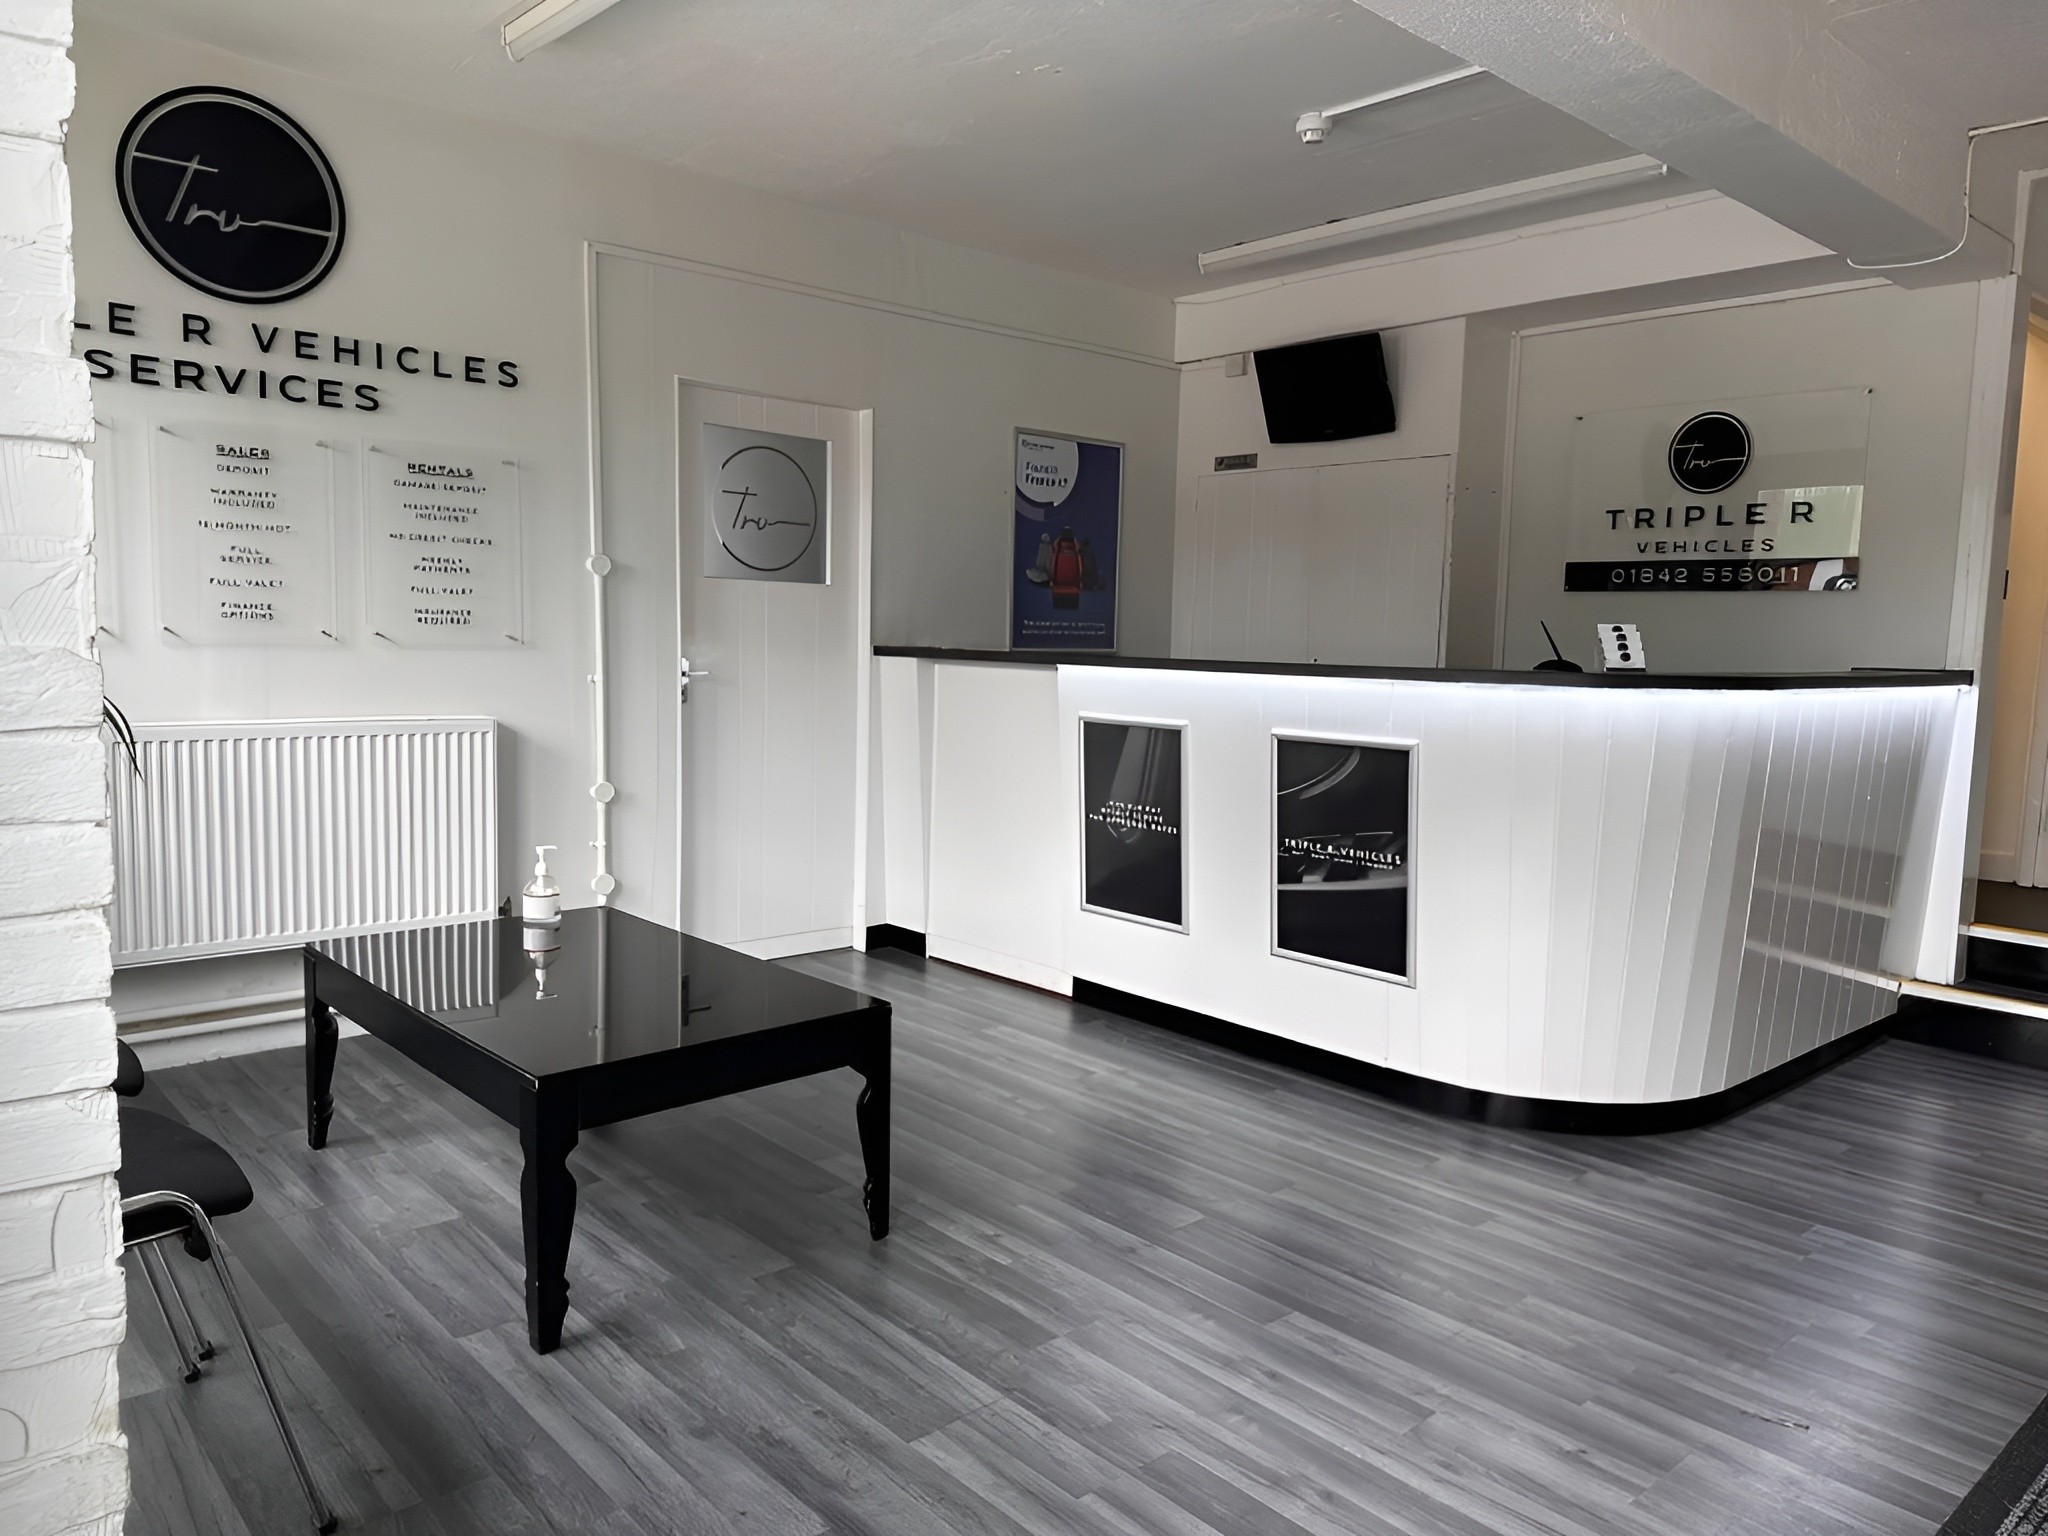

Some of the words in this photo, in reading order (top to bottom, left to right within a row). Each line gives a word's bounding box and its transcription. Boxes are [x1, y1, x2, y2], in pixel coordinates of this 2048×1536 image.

[182, 313, 212, 346] R
[251, 322, 520, 388] VEHICLES
[84, 349, 380, 411] SERVICES
[1606, 503, 1767, 530] TRIPLE
[1791, 501, 1814, 523] R
[1637, 538, 1774, 554] VEHICLES
[1612, 568, 1687, 583] 01842
